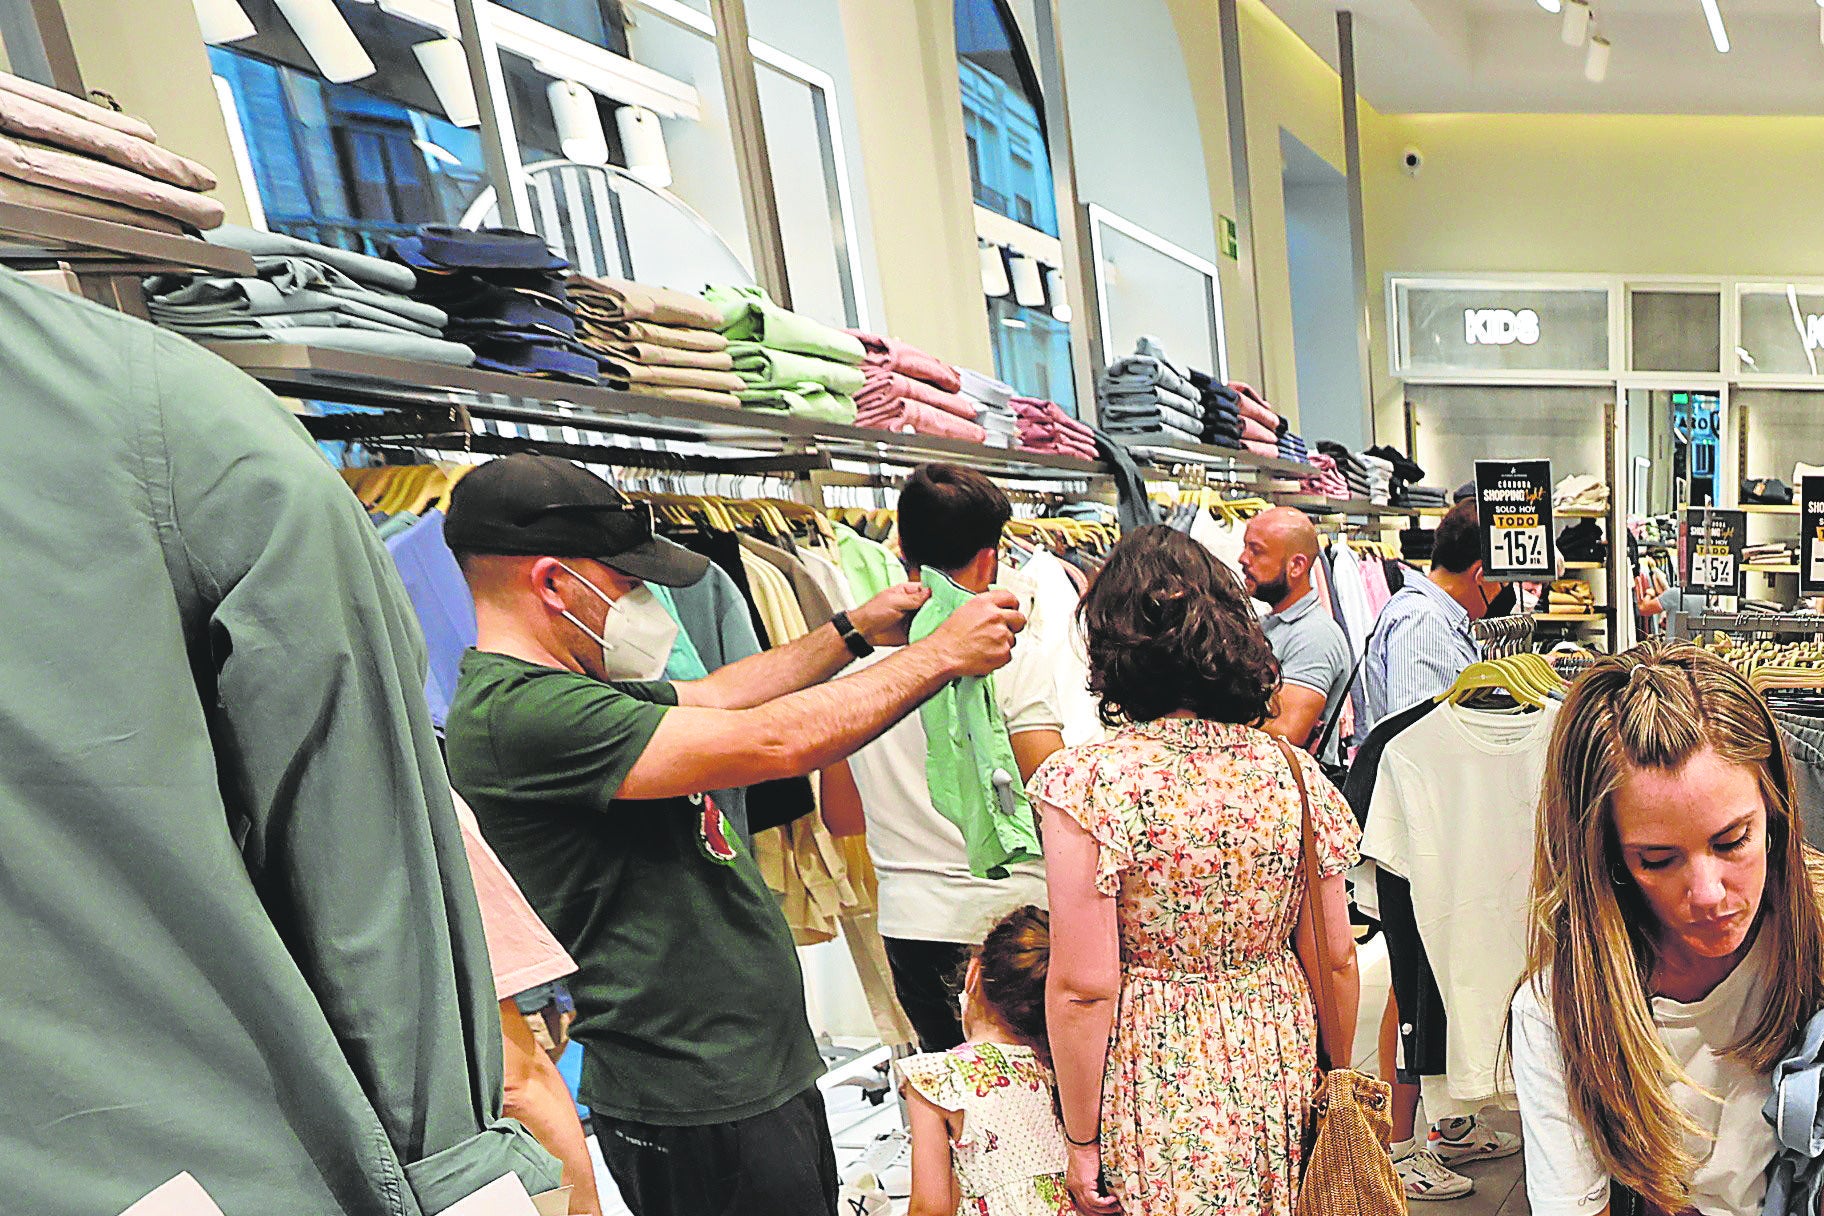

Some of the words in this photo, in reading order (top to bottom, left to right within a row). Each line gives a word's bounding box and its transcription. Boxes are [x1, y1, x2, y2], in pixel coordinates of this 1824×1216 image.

[1464, 308, 1541, 346] KIDS
[1483, 488, 1525, 502] SHOPPING
[1495, 505, 1516, 513] SOLO
[1519, 505, 1535, 513] HOY
[1498, 517, 1535, 526] TODO
[1495, 531, 1541, 566] -15%
